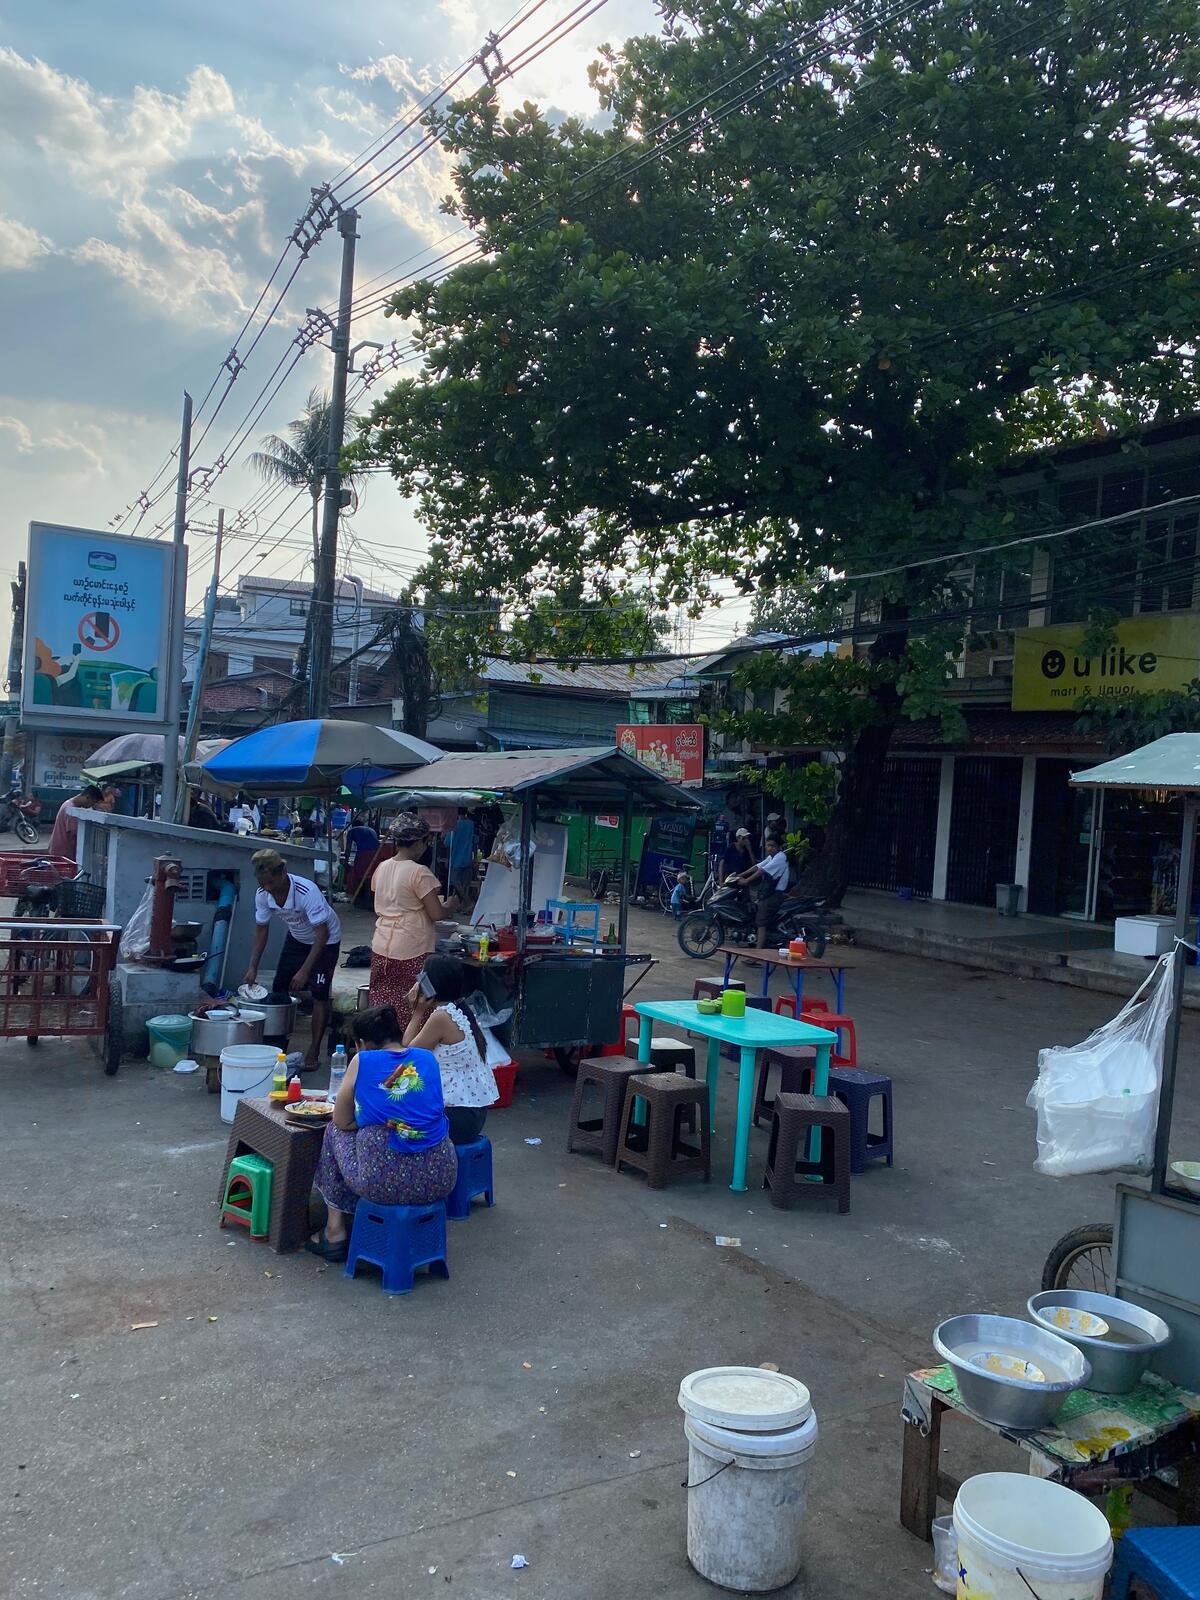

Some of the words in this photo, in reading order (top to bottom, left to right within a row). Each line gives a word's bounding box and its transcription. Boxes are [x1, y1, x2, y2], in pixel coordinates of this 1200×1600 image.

[1073, 656, 1091, 677] u
[1101, 646, 1158, 677] like
[1050, 686, 1077, 697] mart
[1082, 685, 1093, 696] &
[316, 973, 326, 984] 14
